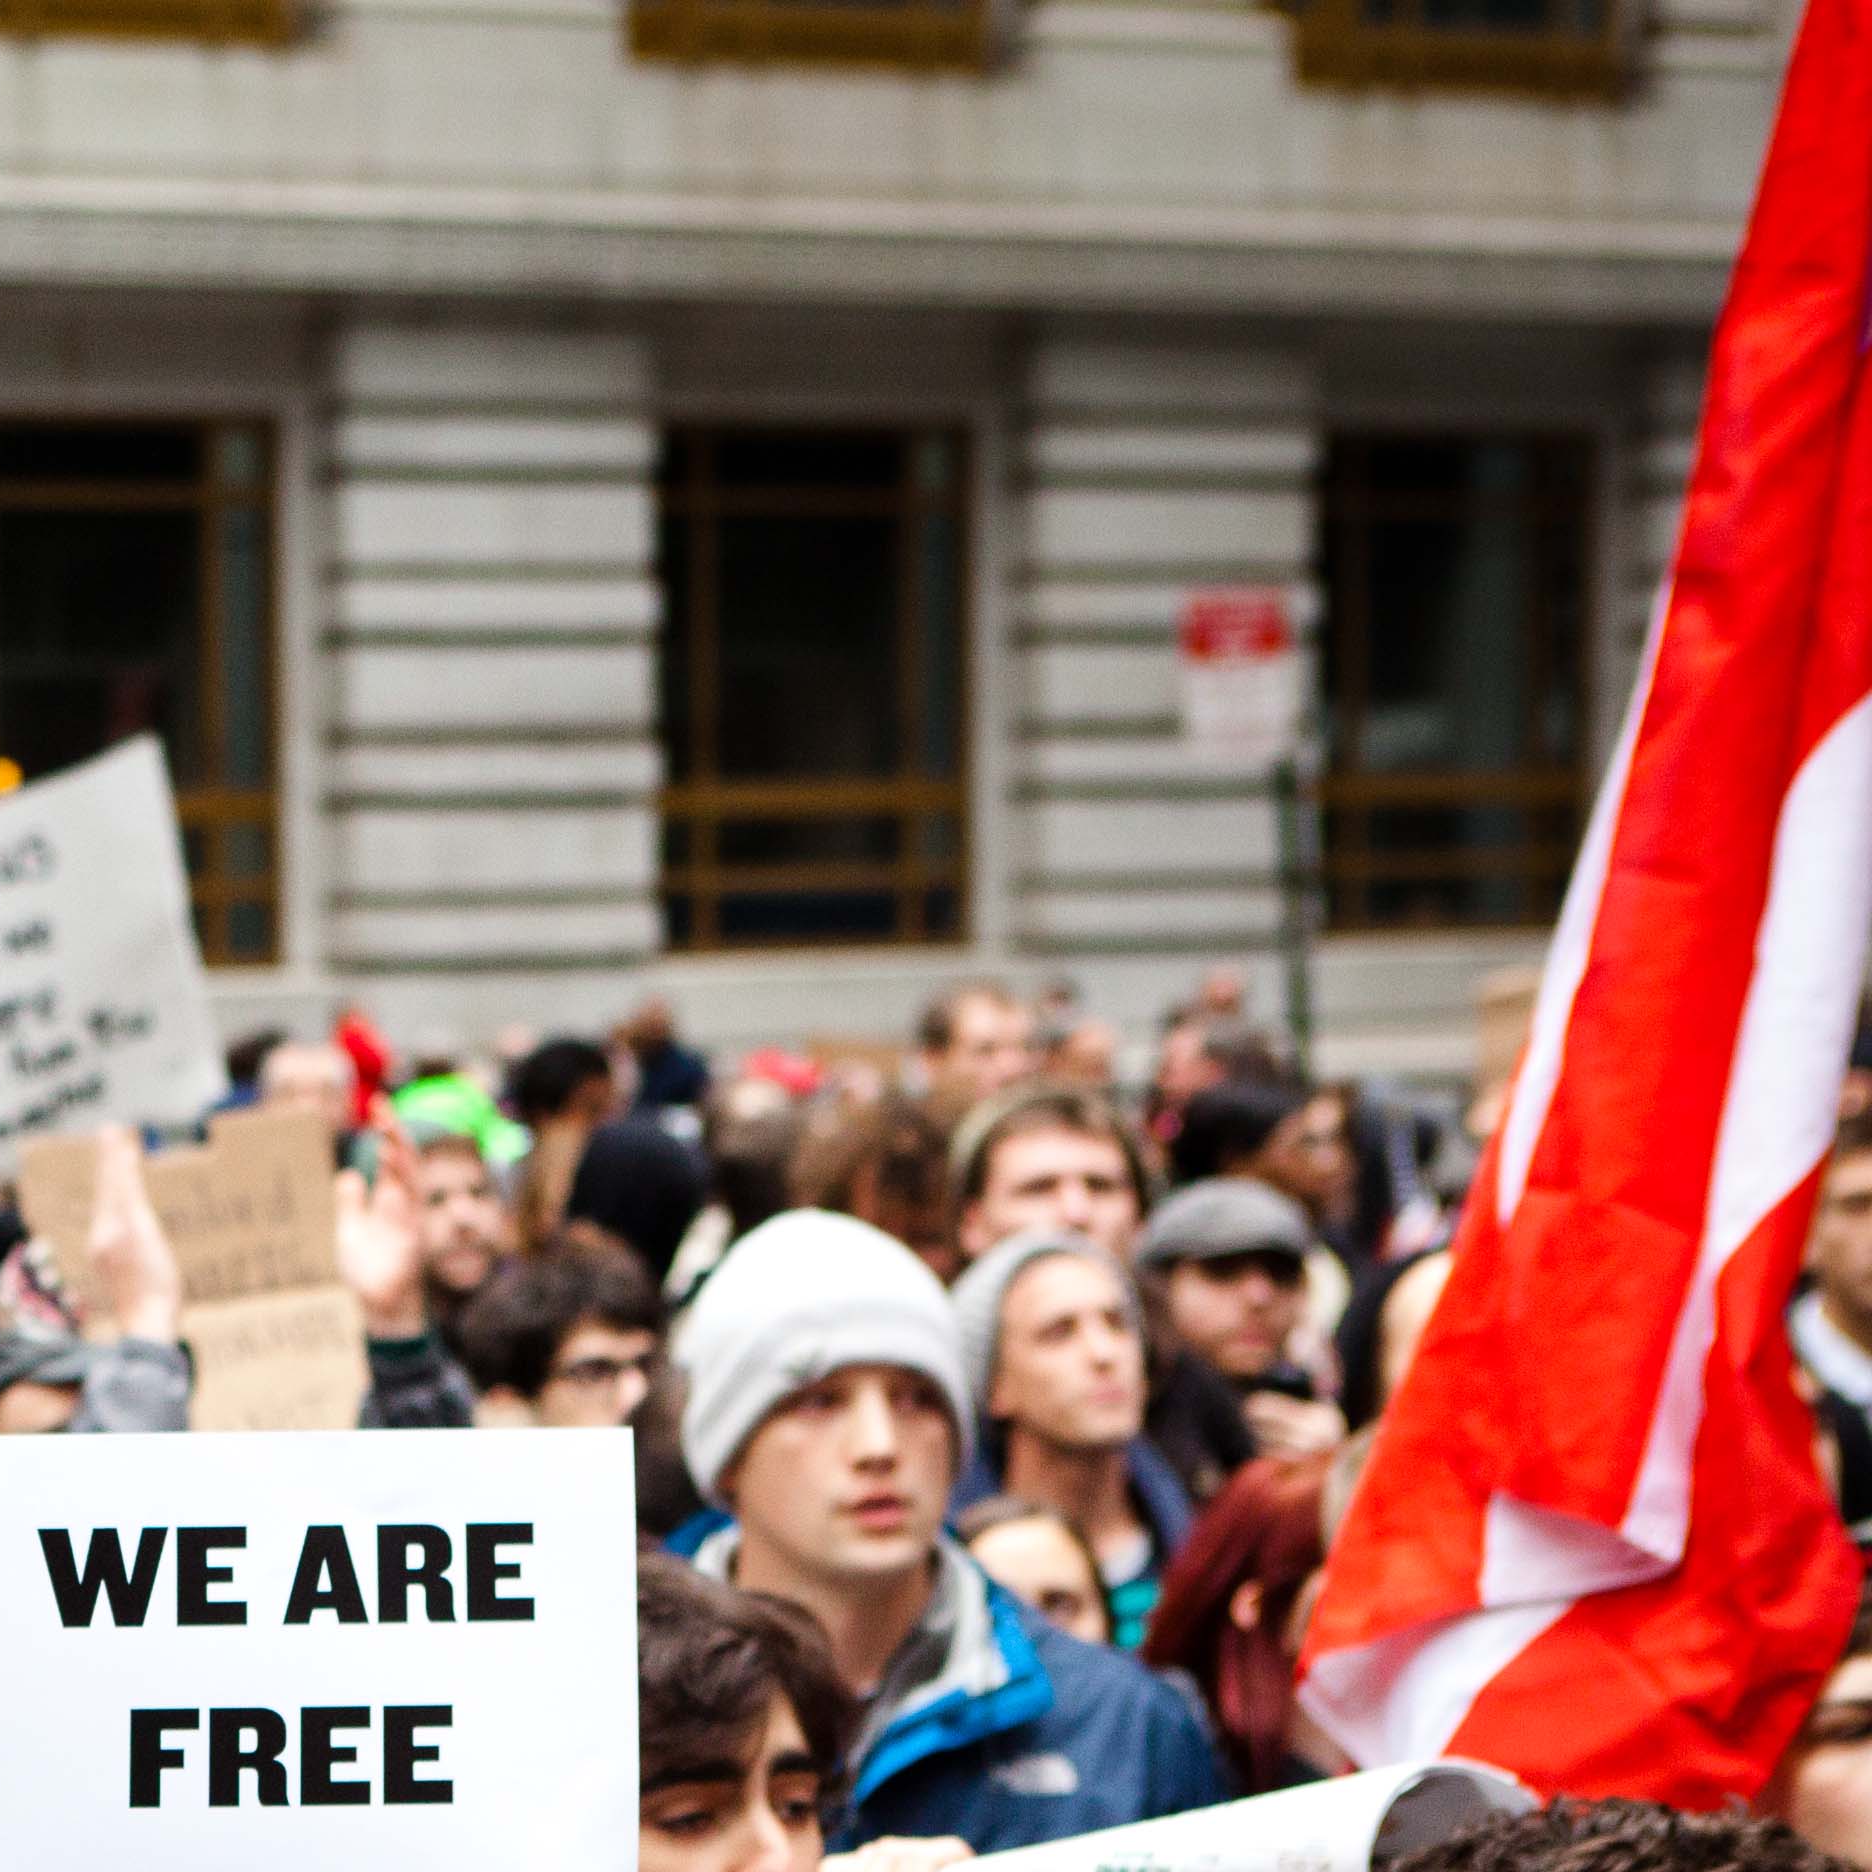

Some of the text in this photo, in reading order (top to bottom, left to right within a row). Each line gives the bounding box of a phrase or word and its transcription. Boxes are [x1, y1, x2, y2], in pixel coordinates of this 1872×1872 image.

[38, 1522, 535, 1628] WE ARE
[129, 1704, 454, 1808] FREE
